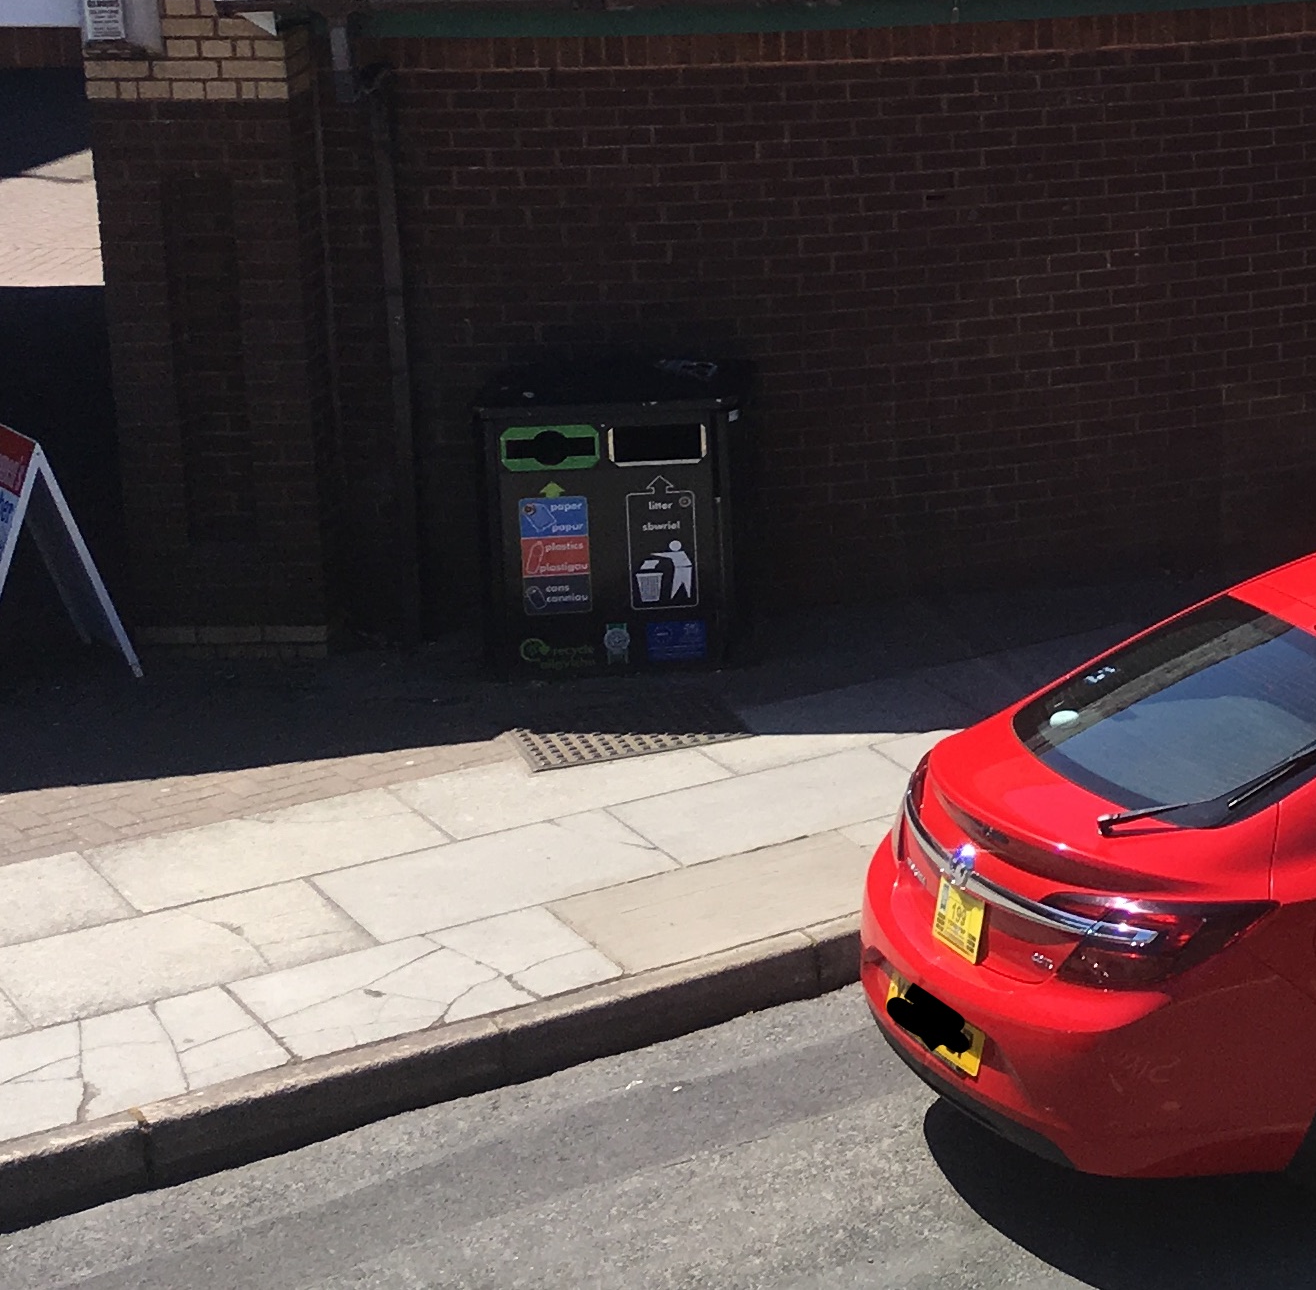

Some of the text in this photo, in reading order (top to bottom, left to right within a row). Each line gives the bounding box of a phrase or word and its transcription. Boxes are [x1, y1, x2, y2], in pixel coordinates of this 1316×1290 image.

[550, 501, 583, 513] paper
[648, 501, 673, 510] litter
[551, 522, 584, 533] papur
[642, 520, 681, 531] sbwriel
[545, 541, 584, 552] plastics
[539, 562, 588, 573] plastigau
[546, 583, 570, 593] cans
[546, 592, 588, 603] canniau
